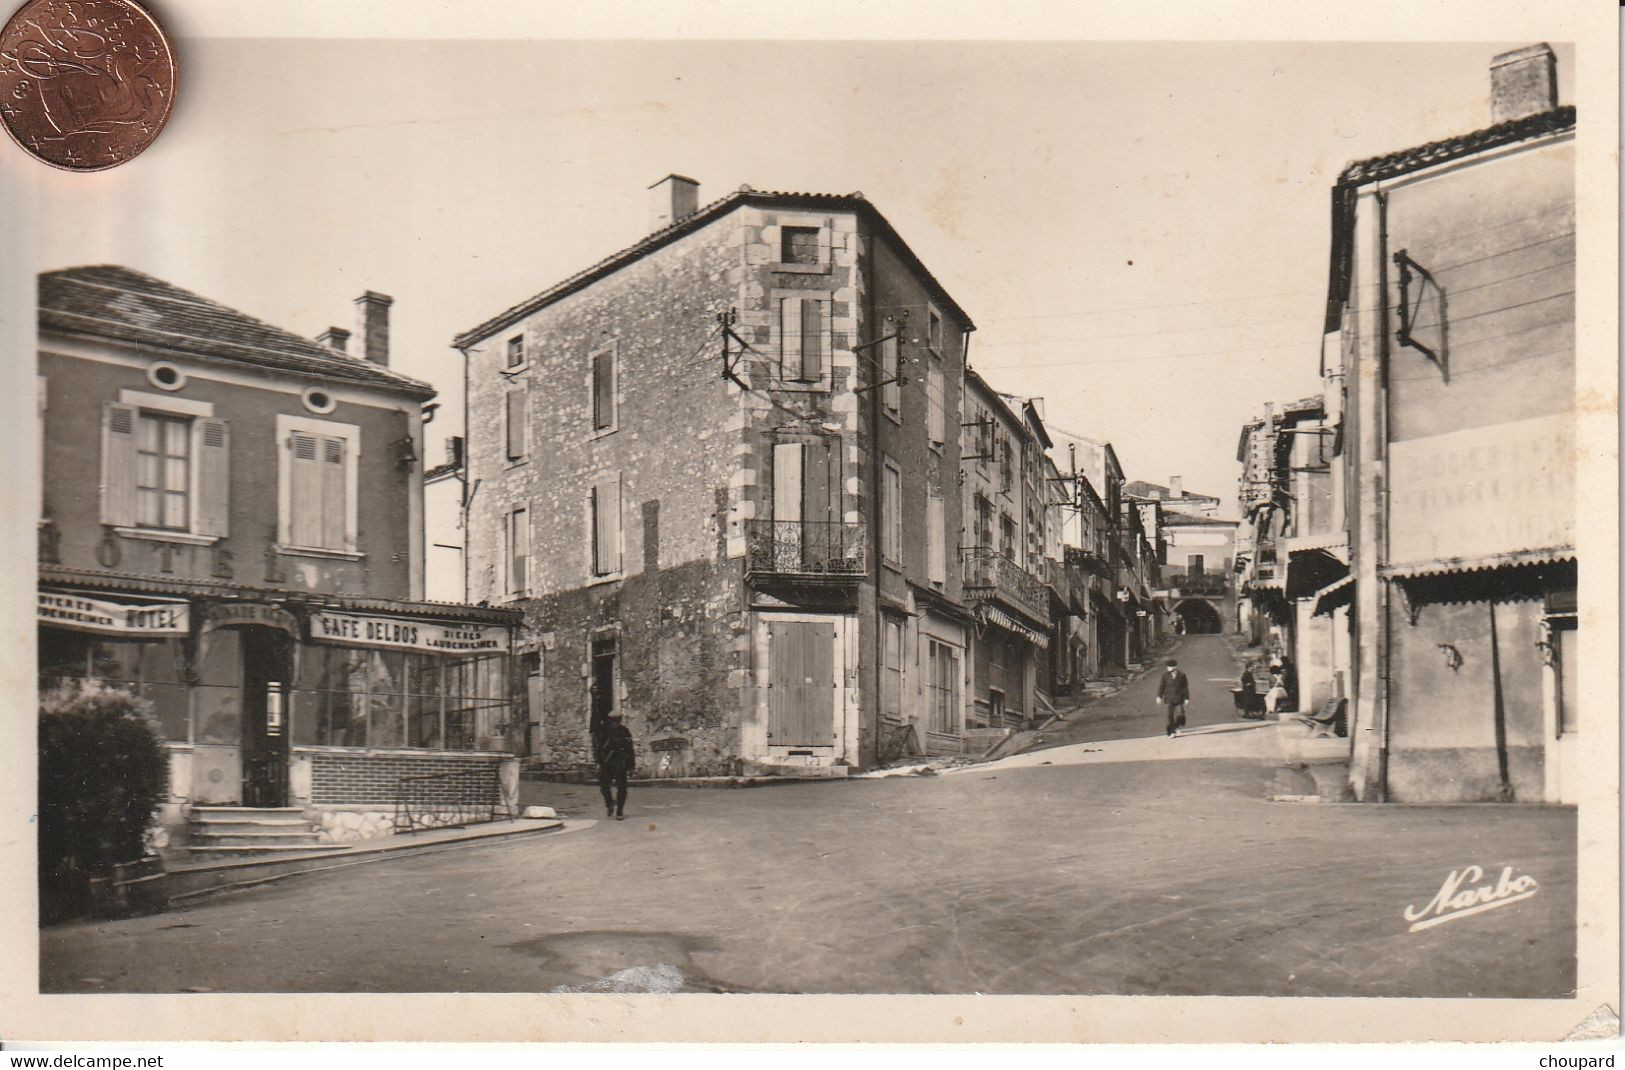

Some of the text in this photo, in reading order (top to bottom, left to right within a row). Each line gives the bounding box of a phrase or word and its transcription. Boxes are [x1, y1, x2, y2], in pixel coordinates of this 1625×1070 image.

[38, 526, 287, 583] HOTEL
[126, 609, 177, 629] HOTEL
[367, 622, 418, 645] DELBOS
